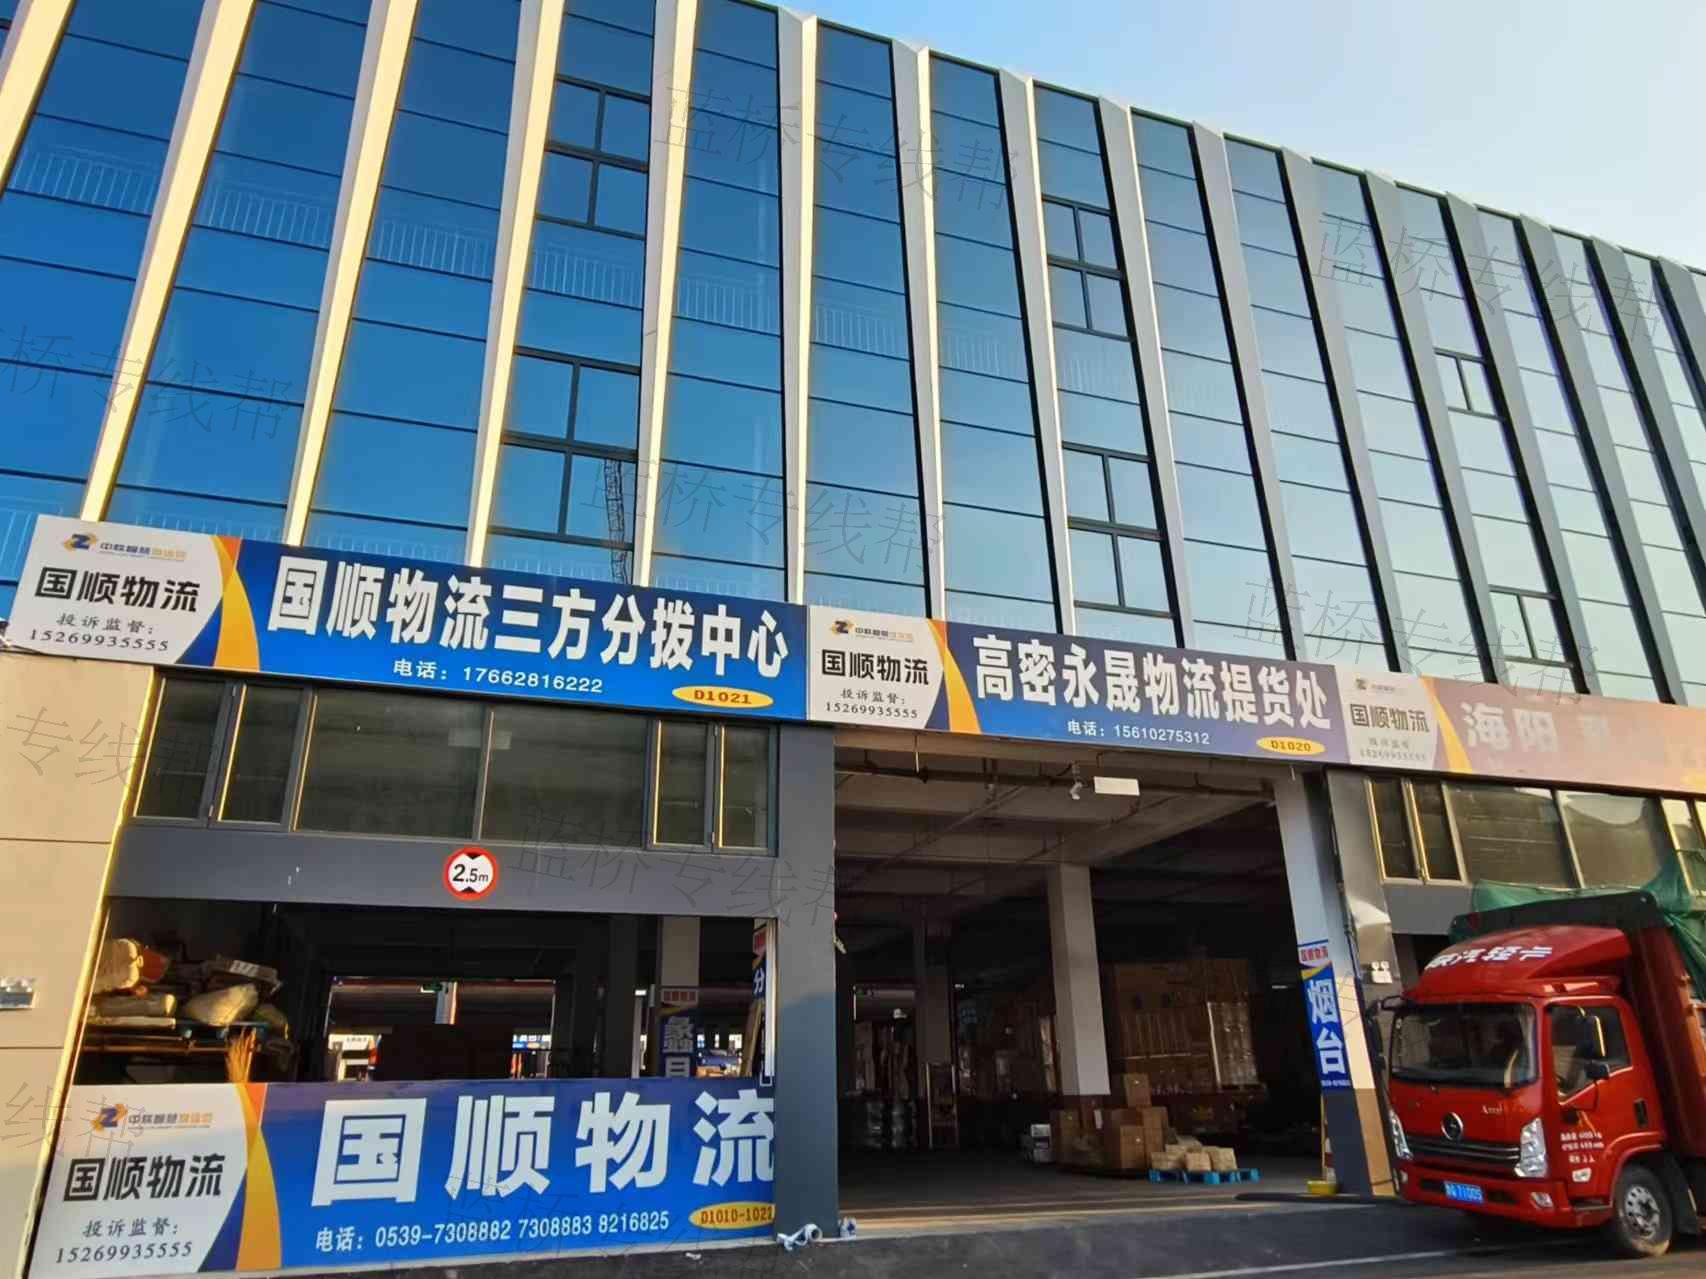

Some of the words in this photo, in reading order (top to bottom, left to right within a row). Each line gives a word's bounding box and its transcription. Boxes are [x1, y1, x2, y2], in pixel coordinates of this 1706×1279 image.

[34, 566, 201, 612] 国顺物流
[267, 555, 788, 678] 国顺物流三方分拨中心
[29, 629, 168, 652] 15269935555
[463, 667, 603, 693] 17662816222
[822, 649, 929, 685] 国顺物流
[973, 634, 1331, 729] 高密永晟物流提货处
[826, 702, 918, 719] 15269935555
[1350, 704, 1430, 732] 国顺物流
[1113, 725, 1210, 745] 15610275312
[453, 864, 488, 883] 2.5m
[311, 1089, 775, 1206] 国顺物流
[63, 1154, 225, 1201] 国顺物流
[375, 1220, 511, 1249] 0539-7308882
[518, 1215, 592, 1239] 7308883
[599, 1211, 669, 1234] 8216825
[55, 1241, 193, 1264] 15269935555
